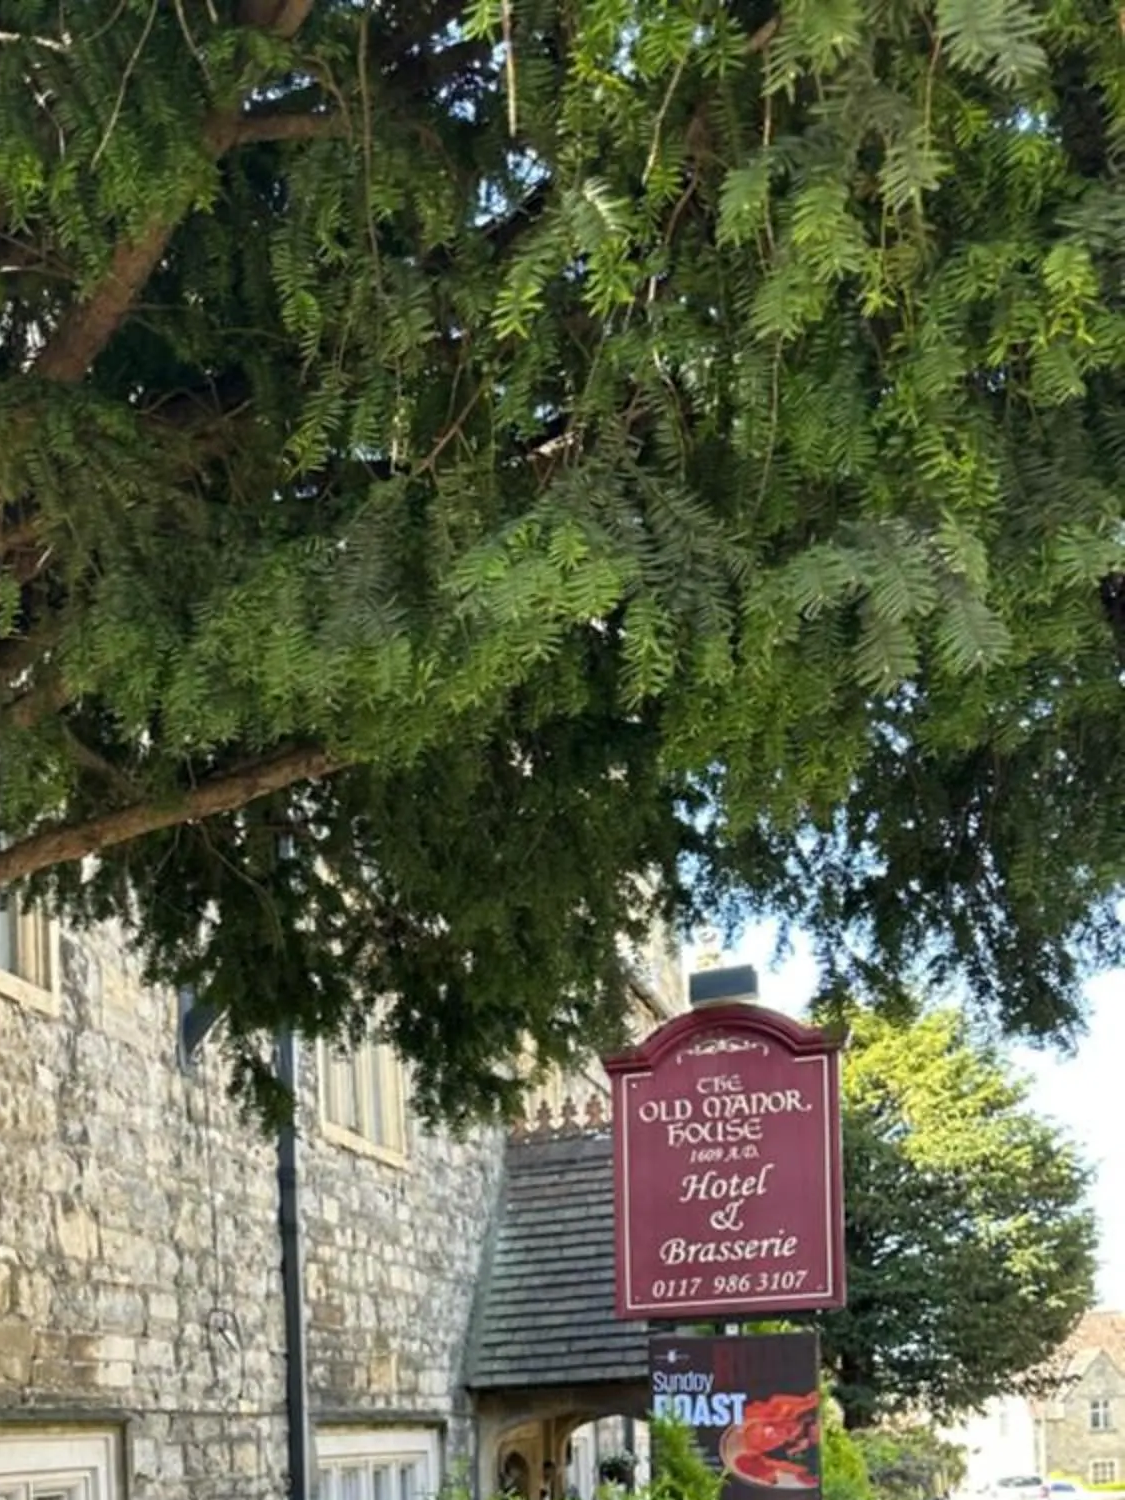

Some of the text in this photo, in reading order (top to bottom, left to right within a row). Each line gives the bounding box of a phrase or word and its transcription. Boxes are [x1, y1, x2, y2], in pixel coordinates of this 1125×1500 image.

[638, 1100, 693, 1123] OLD
[667, 1117, 764, 1148] HOUSE
[679, 1163, 775, 1203] Hotel
[709, 1199, 745, 1231] &
[659, 1228, 799, 1266] Brasserie
[651, 1270, 809, 1299] 0117 986 3107
[653, 1370, 715, 1395] Sunday
